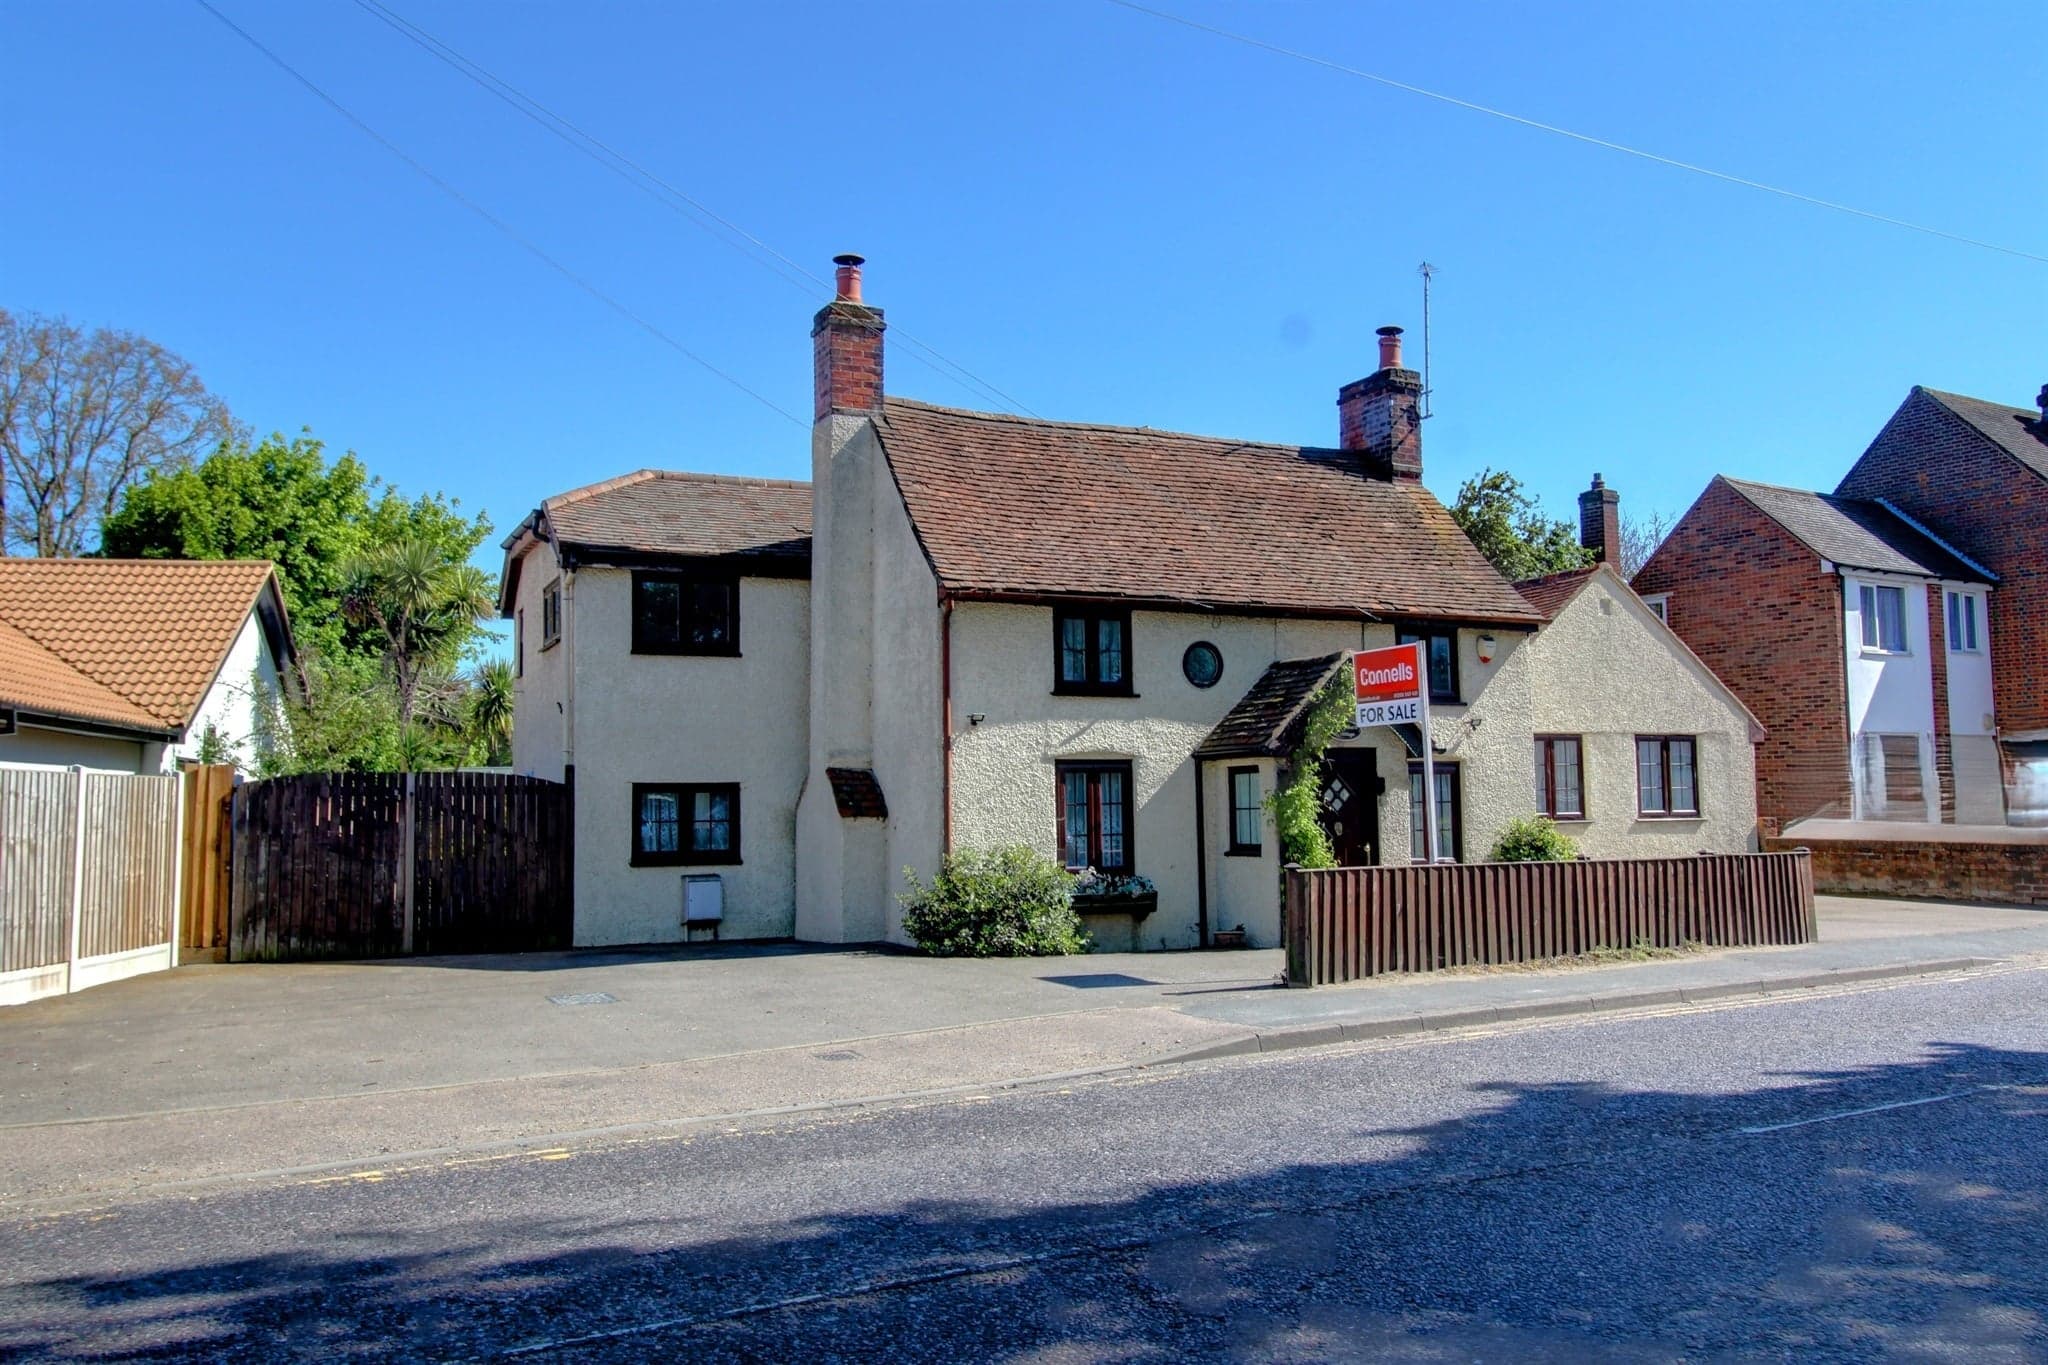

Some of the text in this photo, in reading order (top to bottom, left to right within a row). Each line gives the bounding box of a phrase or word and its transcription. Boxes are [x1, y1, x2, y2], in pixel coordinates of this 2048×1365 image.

[1360, 663, 1413, 686] Connells
[1360, 703, 1417, 722] FOR SALE
